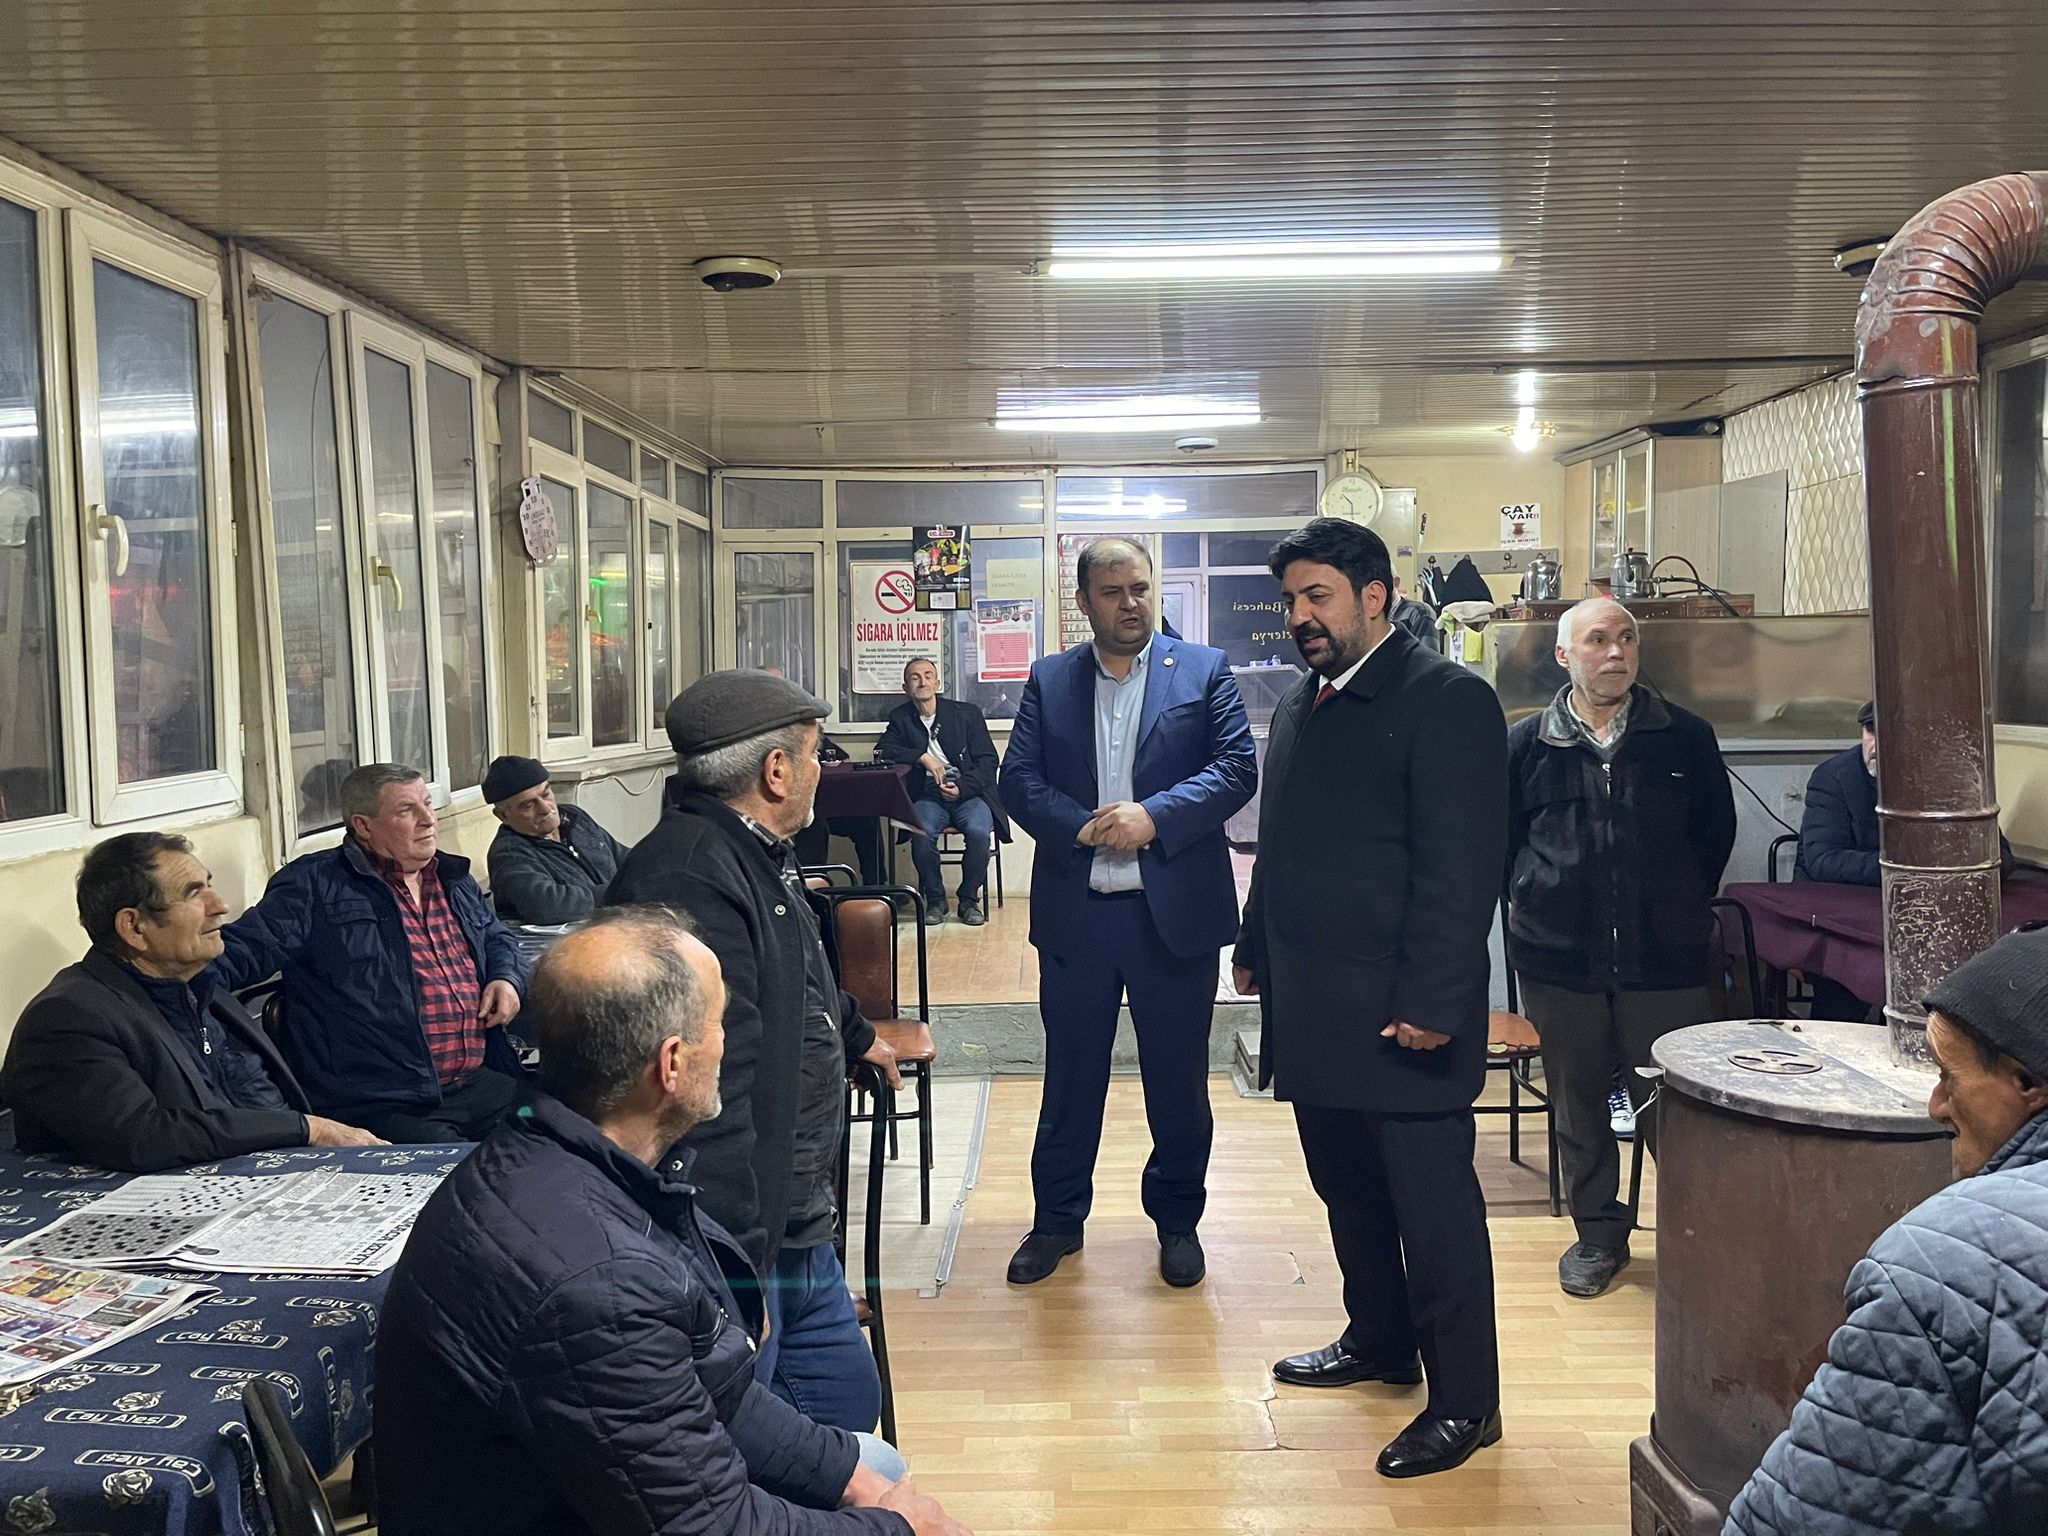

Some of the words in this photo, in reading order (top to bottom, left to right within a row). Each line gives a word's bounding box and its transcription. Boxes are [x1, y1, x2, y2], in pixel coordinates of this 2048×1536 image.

[1501, 504, 1535, 516] ÇAY
[857, 618, 893, 641] SİGARA
[896, 617, 938, 647] İÇİLMEZ
